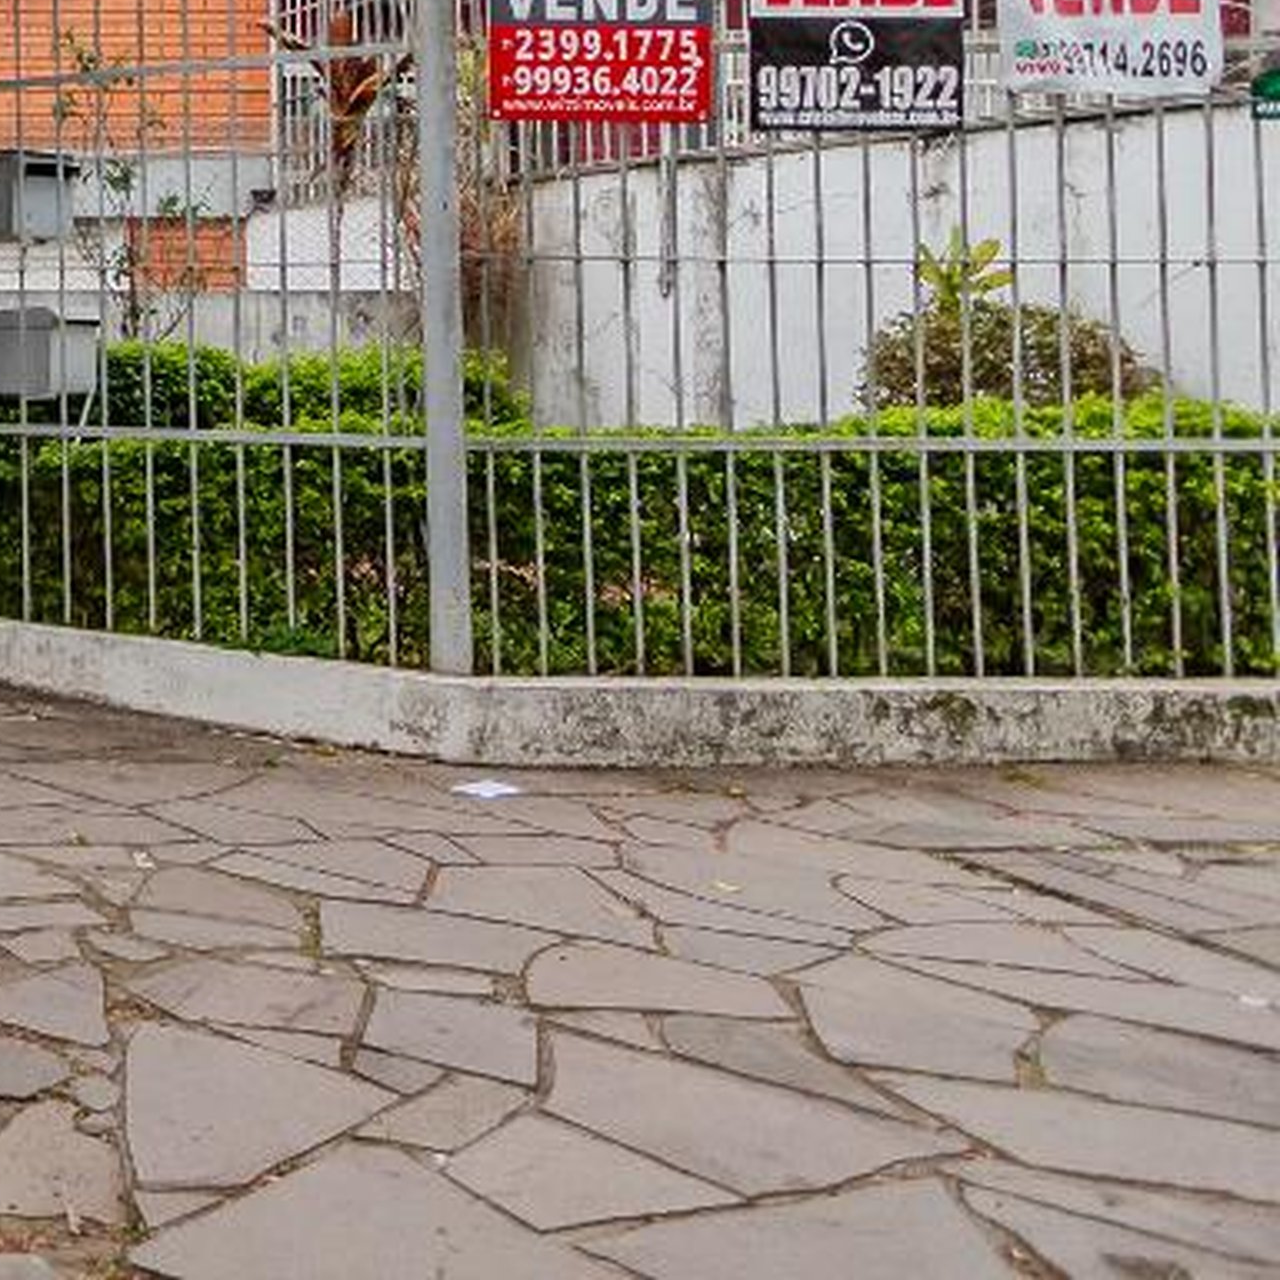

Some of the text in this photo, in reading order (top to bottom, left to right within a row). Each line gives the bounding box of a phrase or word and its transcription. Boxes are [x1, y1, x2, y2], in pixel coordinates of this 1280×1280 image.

[514, 28, 698, 61] 2399.1775
[513, 65, 698, 96] 99936.4022
[758, 65, 959, 110] 99702-1922
